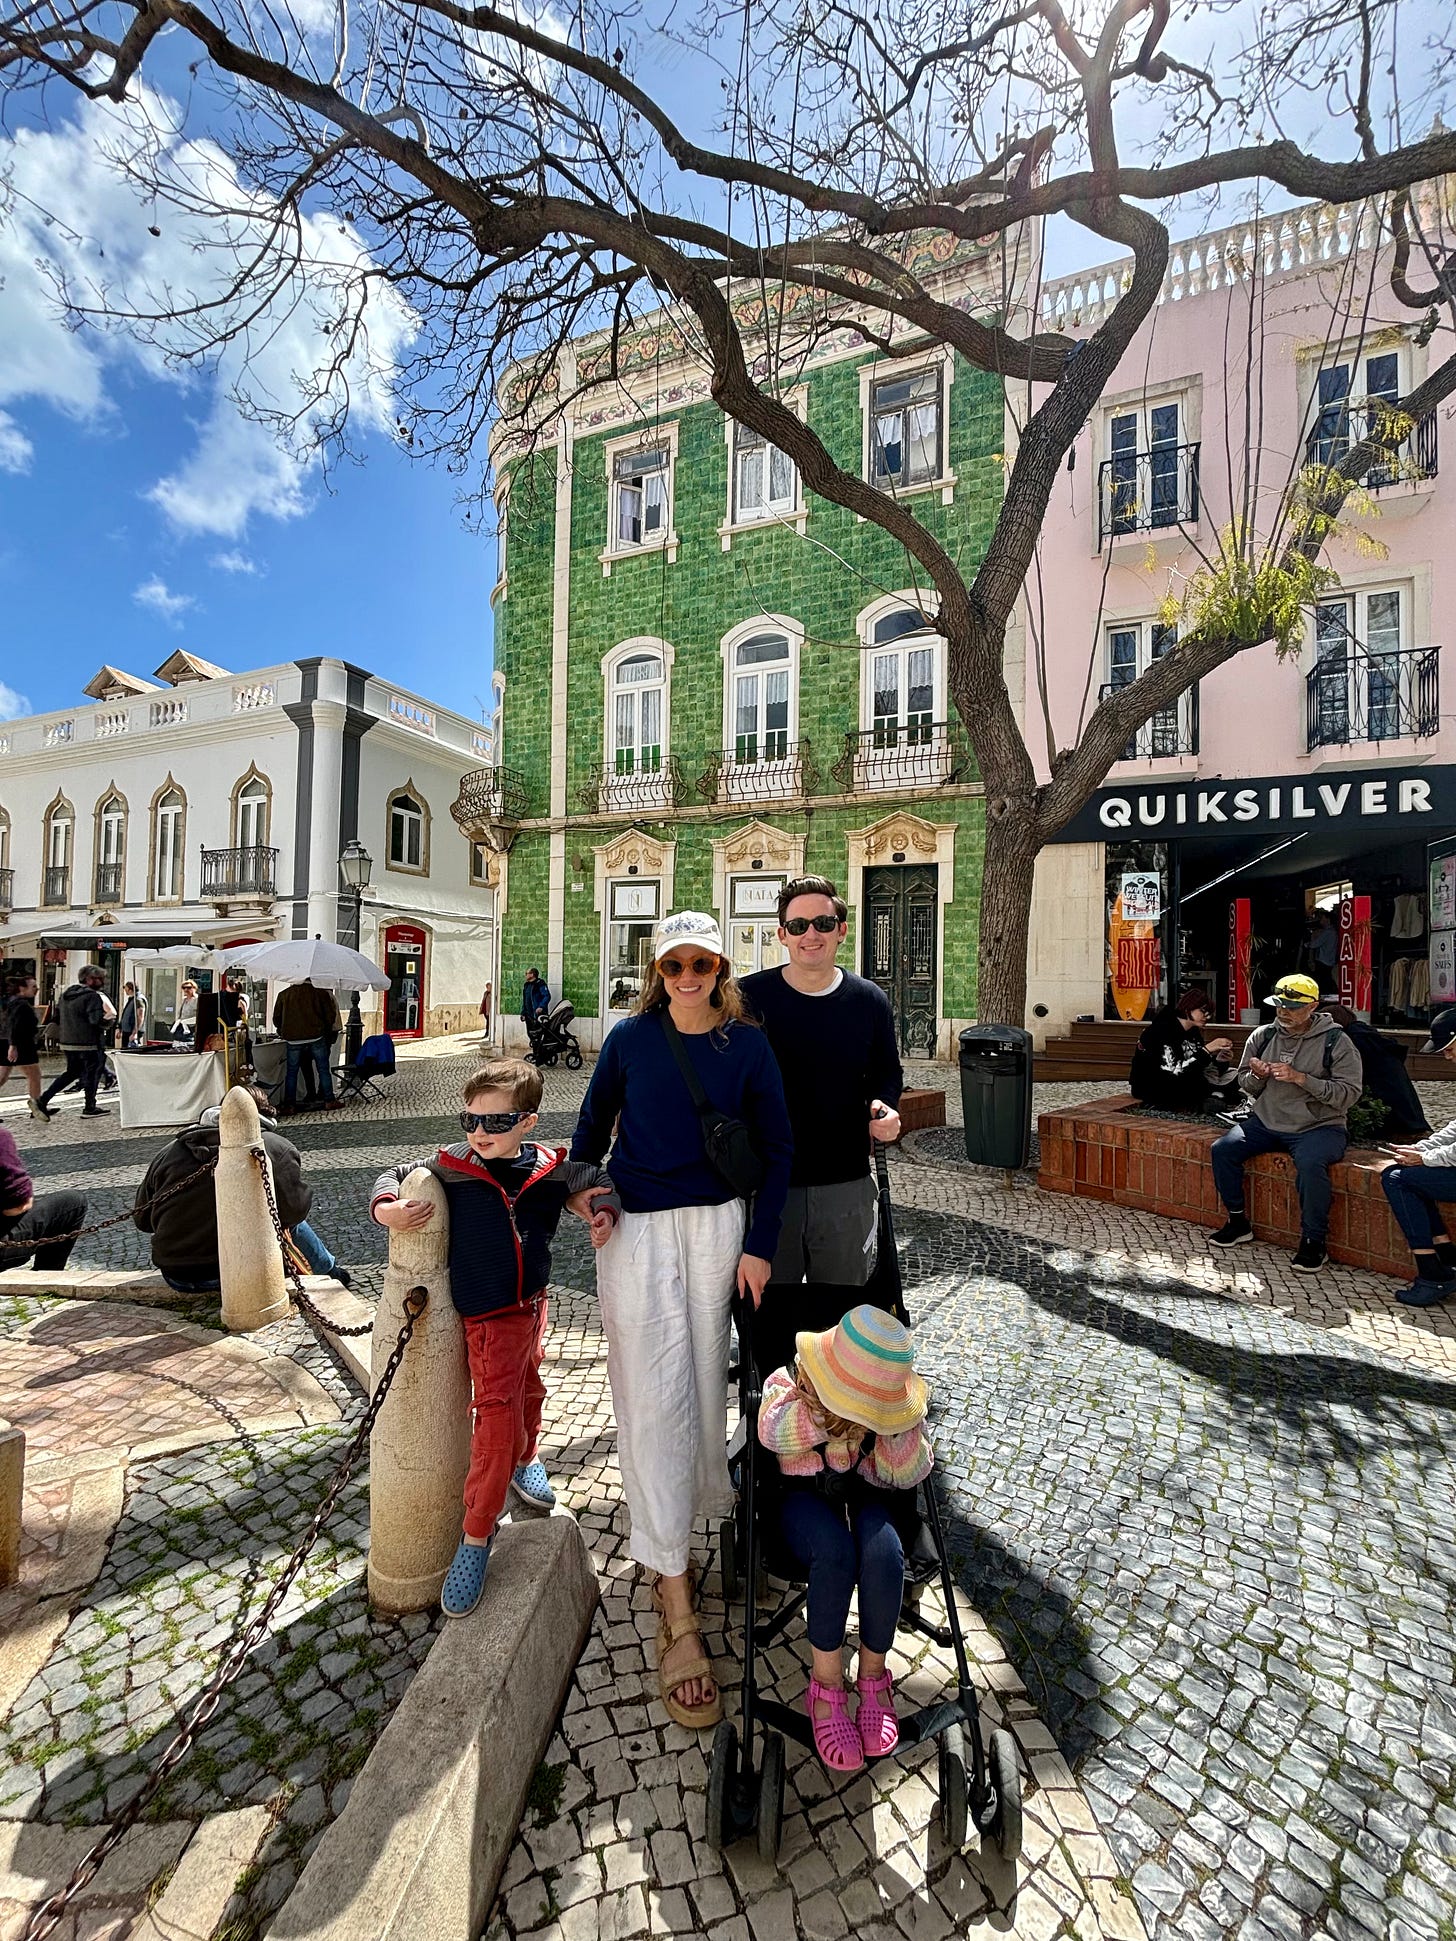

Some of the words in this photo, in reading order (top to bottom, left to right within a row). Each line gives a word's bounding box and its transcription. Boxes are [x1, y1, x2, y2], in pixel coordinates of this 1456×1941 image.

[1099, 779, 1433, 828] QUIKSILVER
[1120, 940, 1157, 987] SALES
[1228, 902, 1236, 1021] SALE
